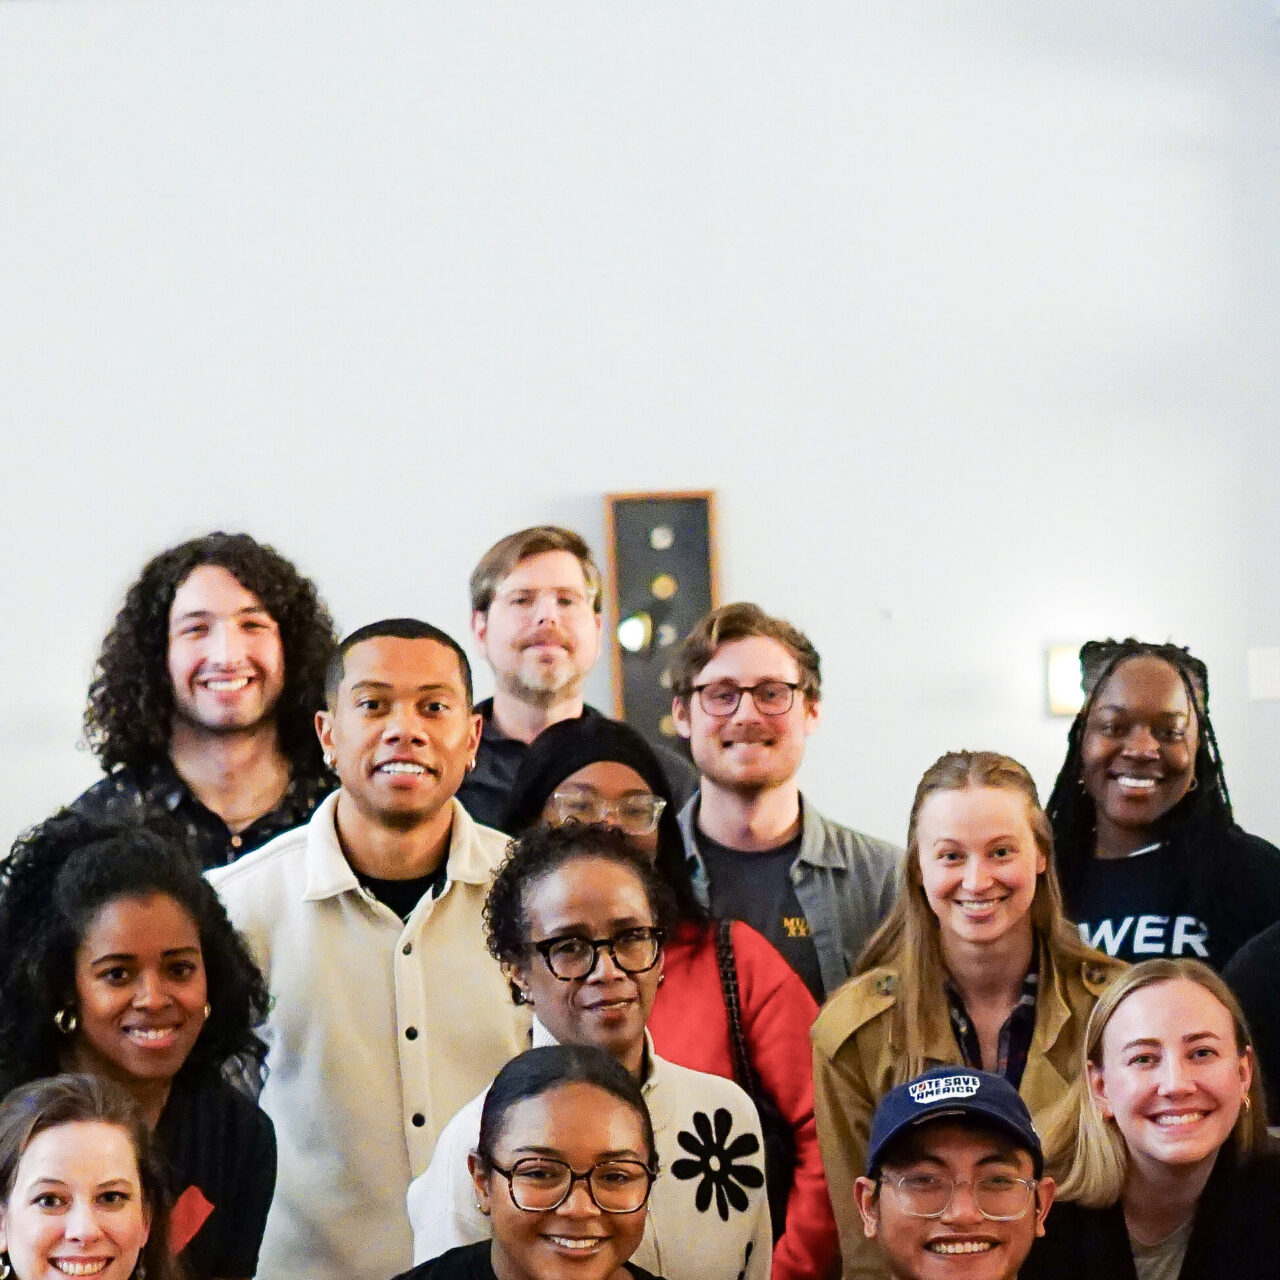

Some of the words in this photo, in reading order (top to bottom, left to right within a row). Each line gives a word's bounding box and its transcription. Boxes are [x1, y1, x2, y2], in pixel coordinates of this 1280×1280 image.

[1077, 914, 1210, 957] WER
[910, 1080, 941, 1095] VOTE
[944, 1076, 978, 1087] SAVE
[916, 1086, 974, 1101] AMERICA
